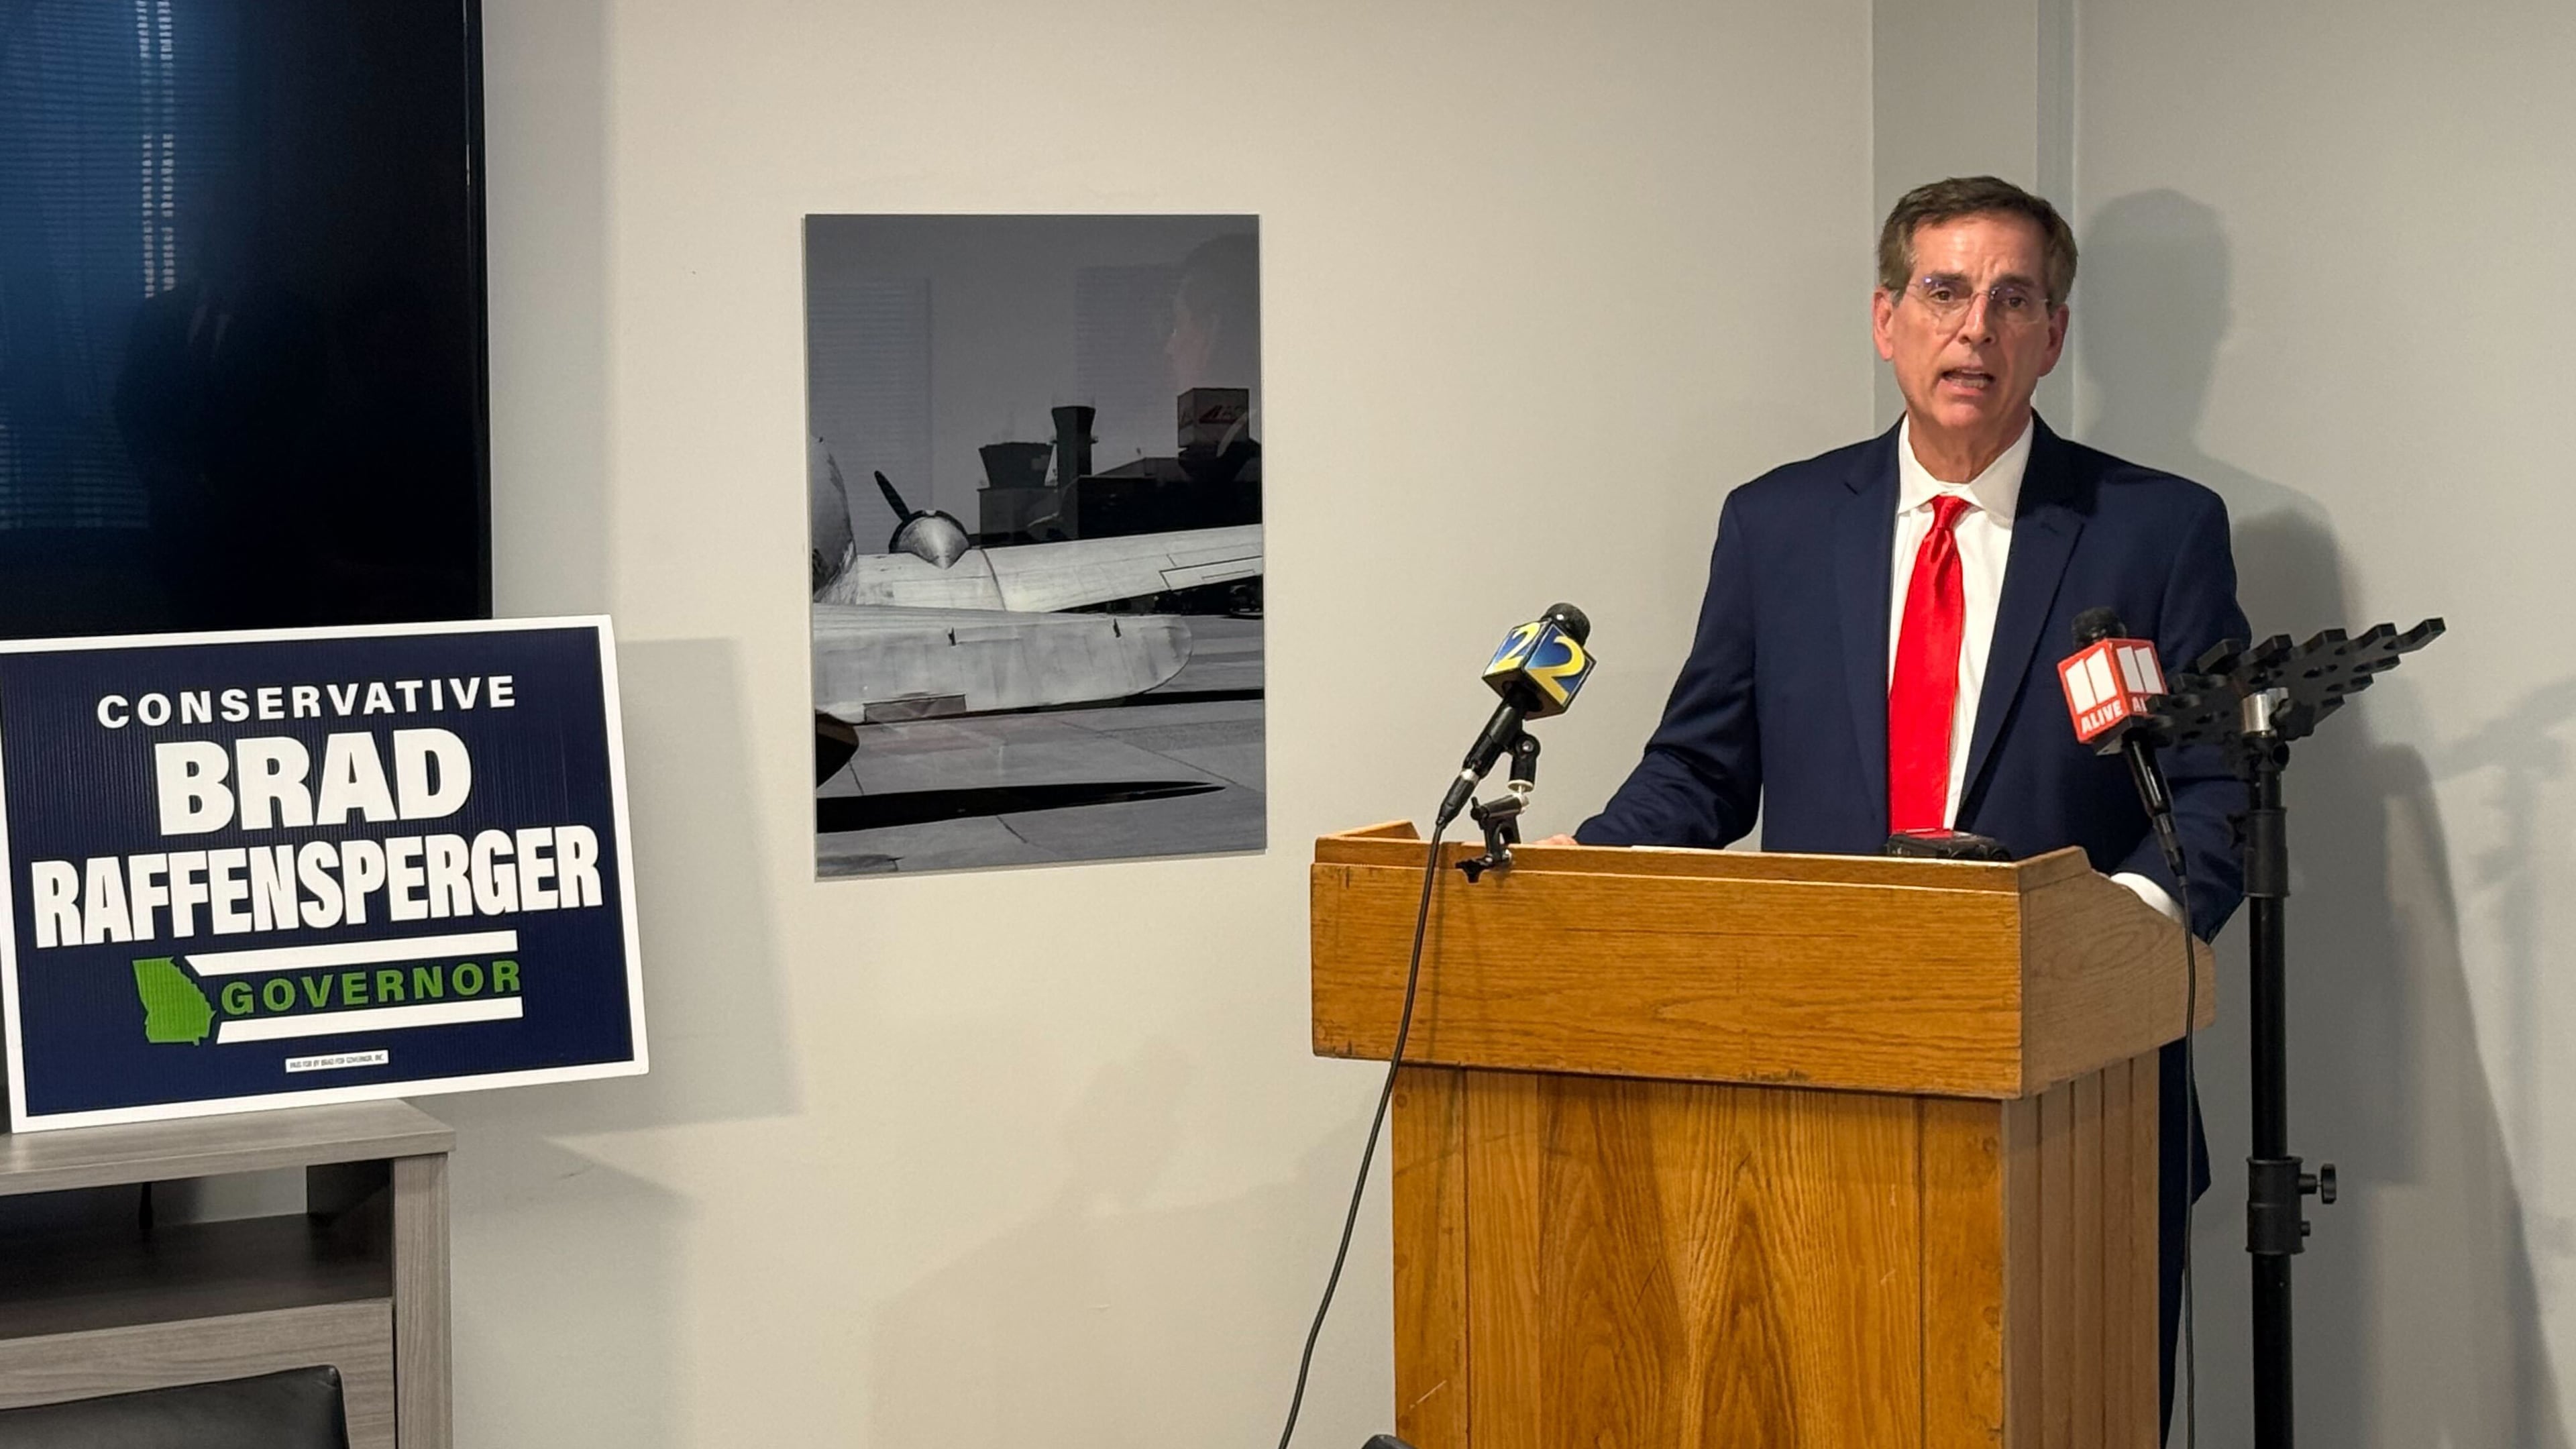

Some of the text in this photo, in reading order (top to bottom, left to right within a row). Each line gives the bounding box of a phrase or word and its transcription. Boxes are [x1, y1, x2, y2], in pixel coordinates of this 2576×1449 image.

[1484, 622, 1540, 675] 2
[1525, 636, 1585, 705] 2
[98, 676, 516, 728] CONSERVATIVE
[2080, 700, 2123, 734] ALIVE
[155, 729, 471, 835] BRAD
[32, 825, 602, 948] RAFFENSPERGER
[221, 960, 521, 1015] GOVERNOR
